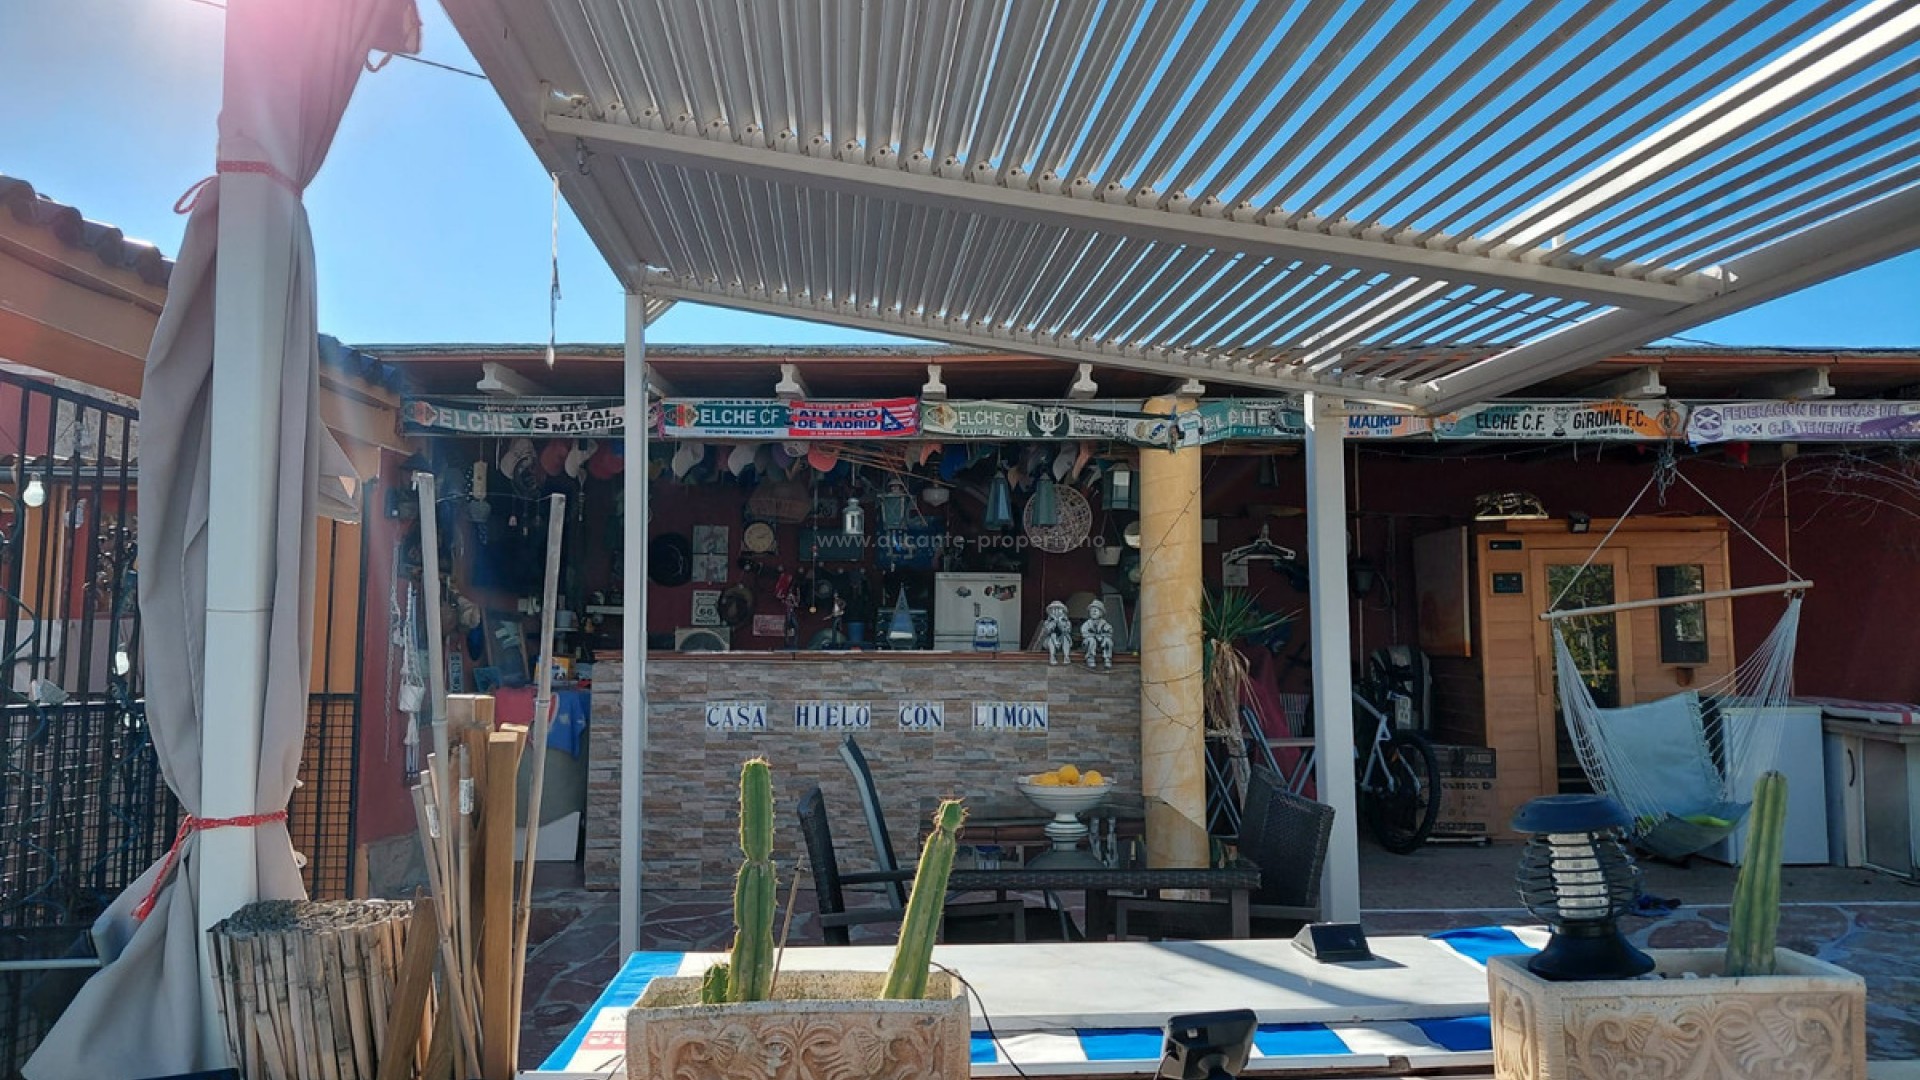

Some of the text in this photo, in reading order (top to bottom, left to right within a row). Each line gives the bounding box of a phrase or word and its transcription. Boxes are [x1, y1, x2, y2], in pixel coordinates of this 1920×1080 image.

[439, 408, 549, 432] ELCHE VS
[551, 416, 623, 432] MADRID
[560, 410, 615, 422] REAL
[700, 409, 780, 424] ELCHE CF
[798, 419, 878, 428] DE MADRID
[959, 411, 1025, 429] ELCHE CF
[1203, 408, 1270, 432] ELCHE
[1348, 414, 1402, 429] MADRID
[1475, 412, 1519, 430] ELCHE
[1522, 413, 1545, 431] C.F.
[1626, 410, 1649, 428] F.C.
[1797, 420, 1861, 434] TENERIFE
[706, 705, 1047, 727] CASA HIELO CON LIMON
